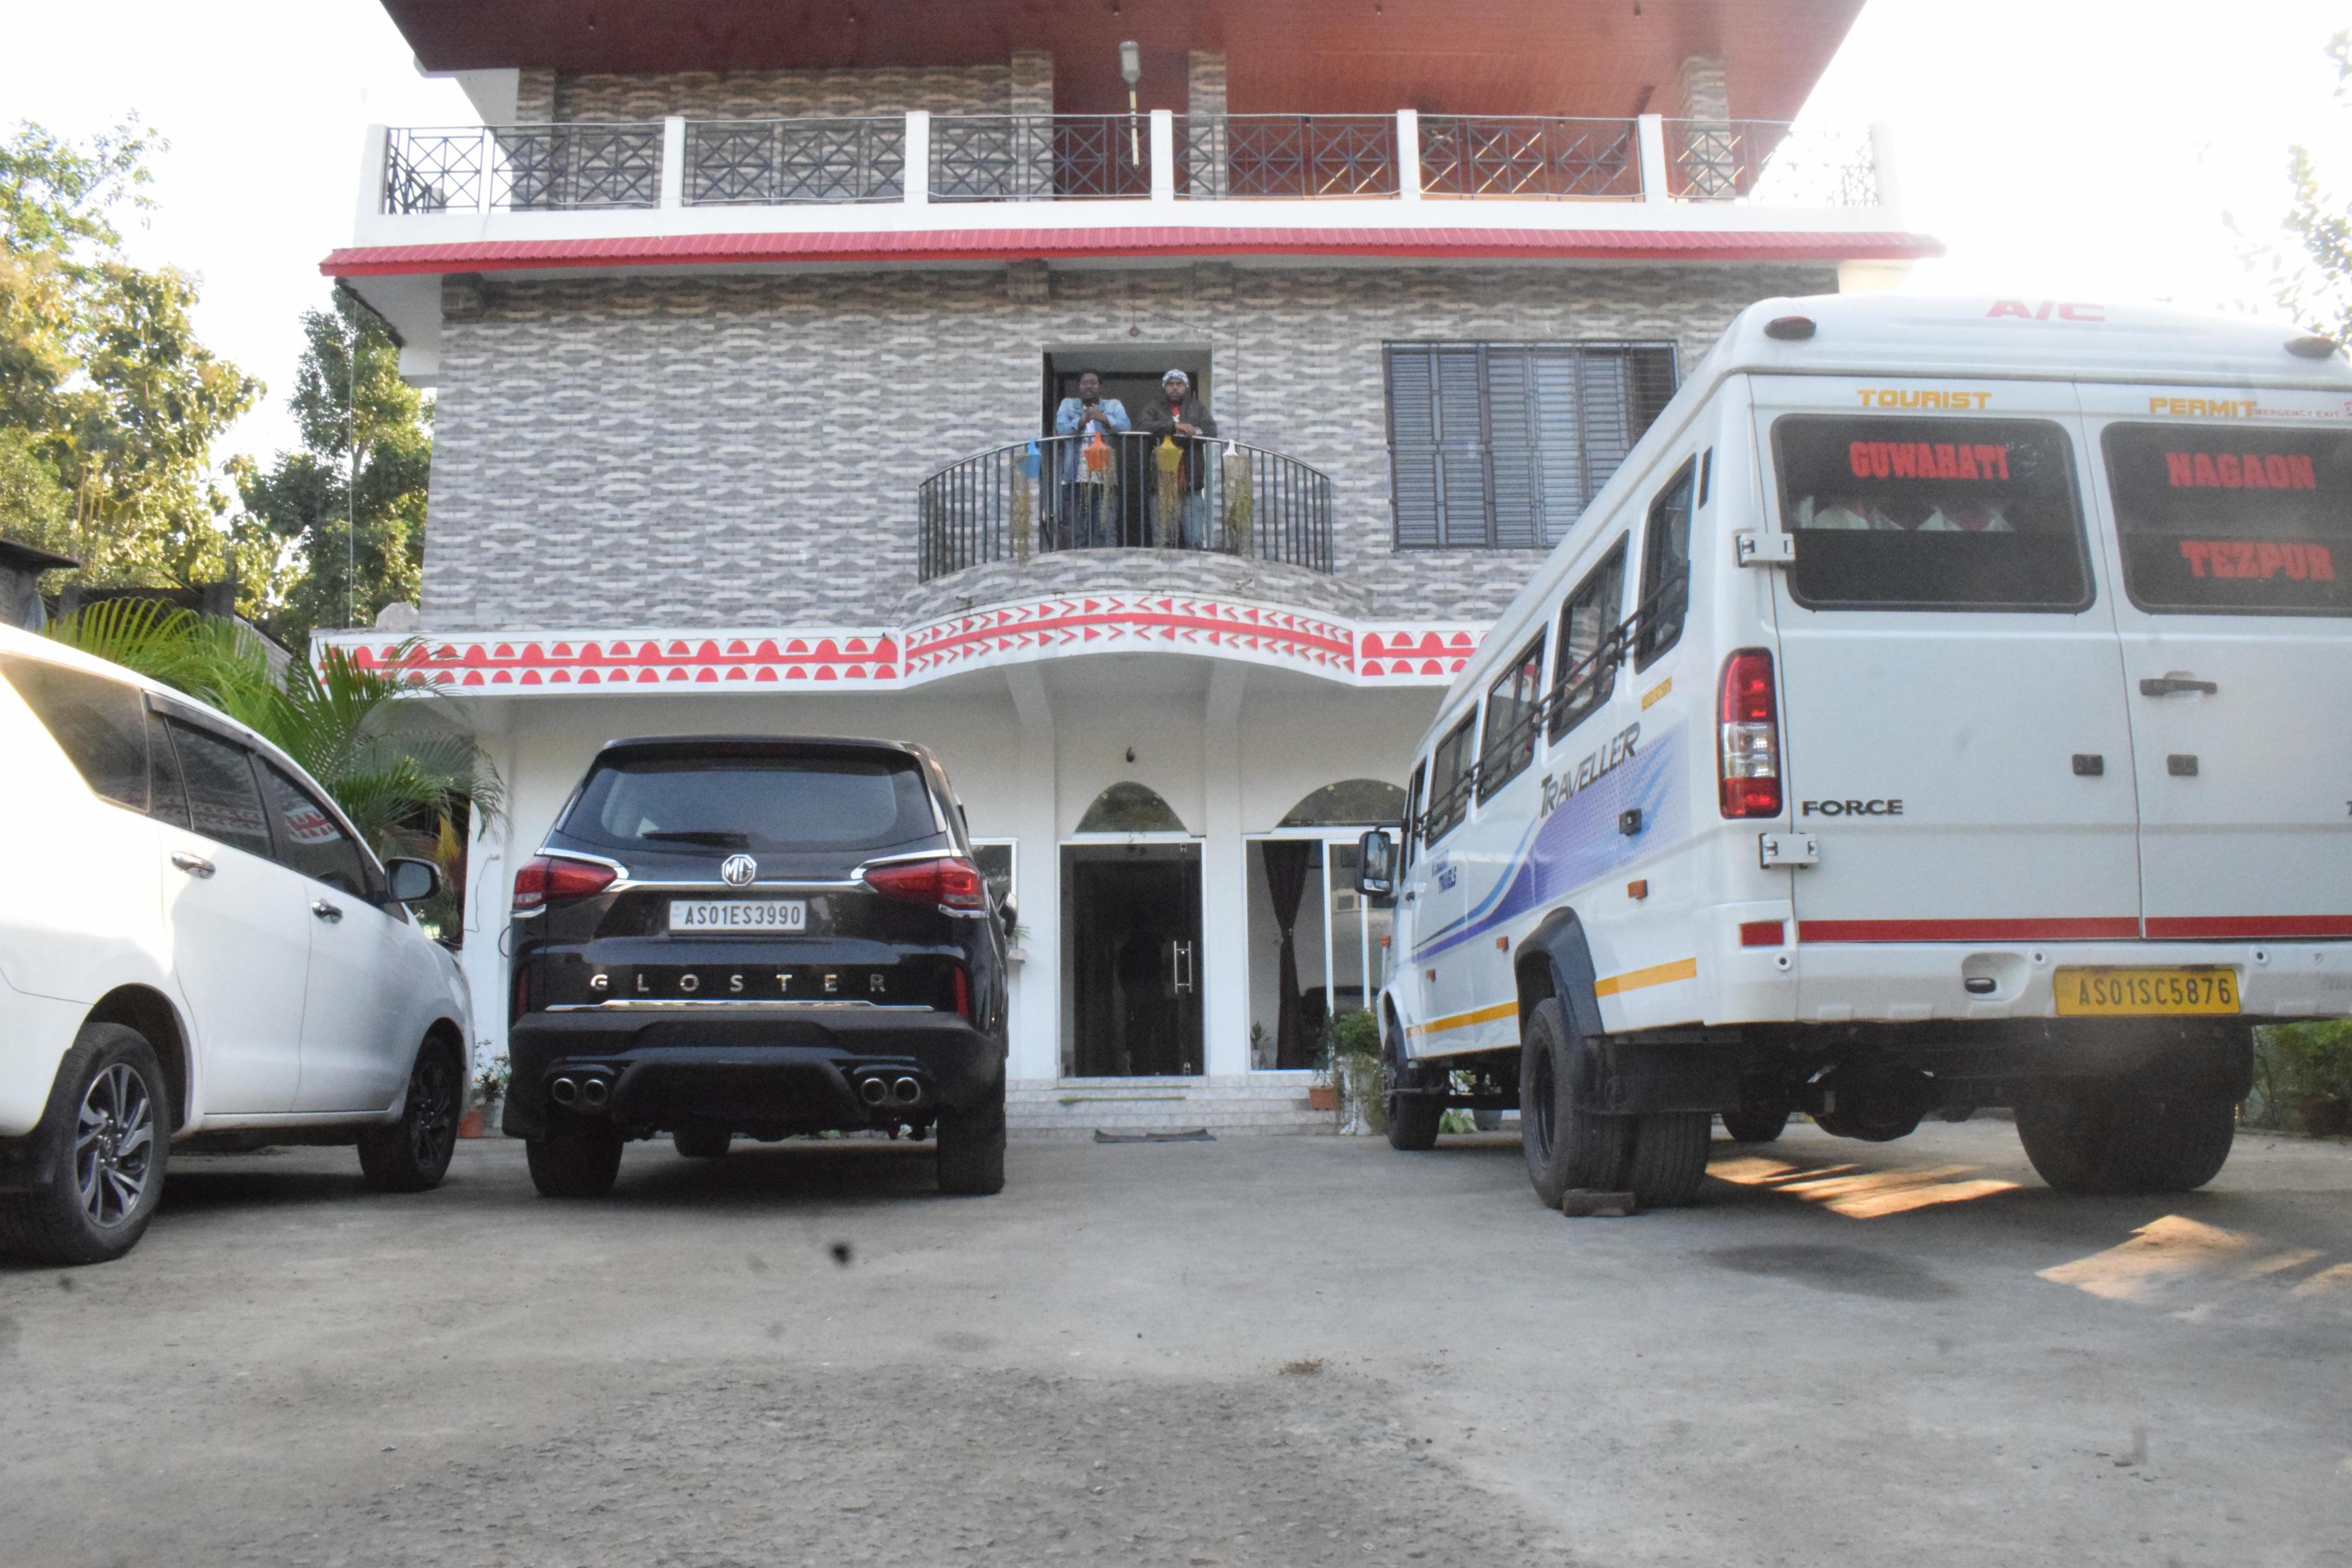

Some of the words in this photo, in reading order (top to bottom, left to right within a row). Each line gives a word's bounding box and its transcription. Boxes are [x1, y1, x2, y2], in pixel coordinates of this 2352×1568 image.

[1986, 299, 2105, 321] A/C
[1857, 389, 1992, 409] TOURIST
[2149, 397, 2257, 418] PERMIT
[1849, 441, 2009, 480] GUWAHATI
[2165, 452, 2316, 489] NAGAON
[2180, 539, 2336, 581] TEZPUR
[1540, 721, 1641, 818] TRAVELLER
[1802, 799, 1904, 816] FORCE
[725, 856, 754, 883] MG
[685, 906, 801, 925] AS01ES3990
[590, 974, 885, 991] GLOSTER
[2078, 978, 2232, 1005] AS01SC5876
